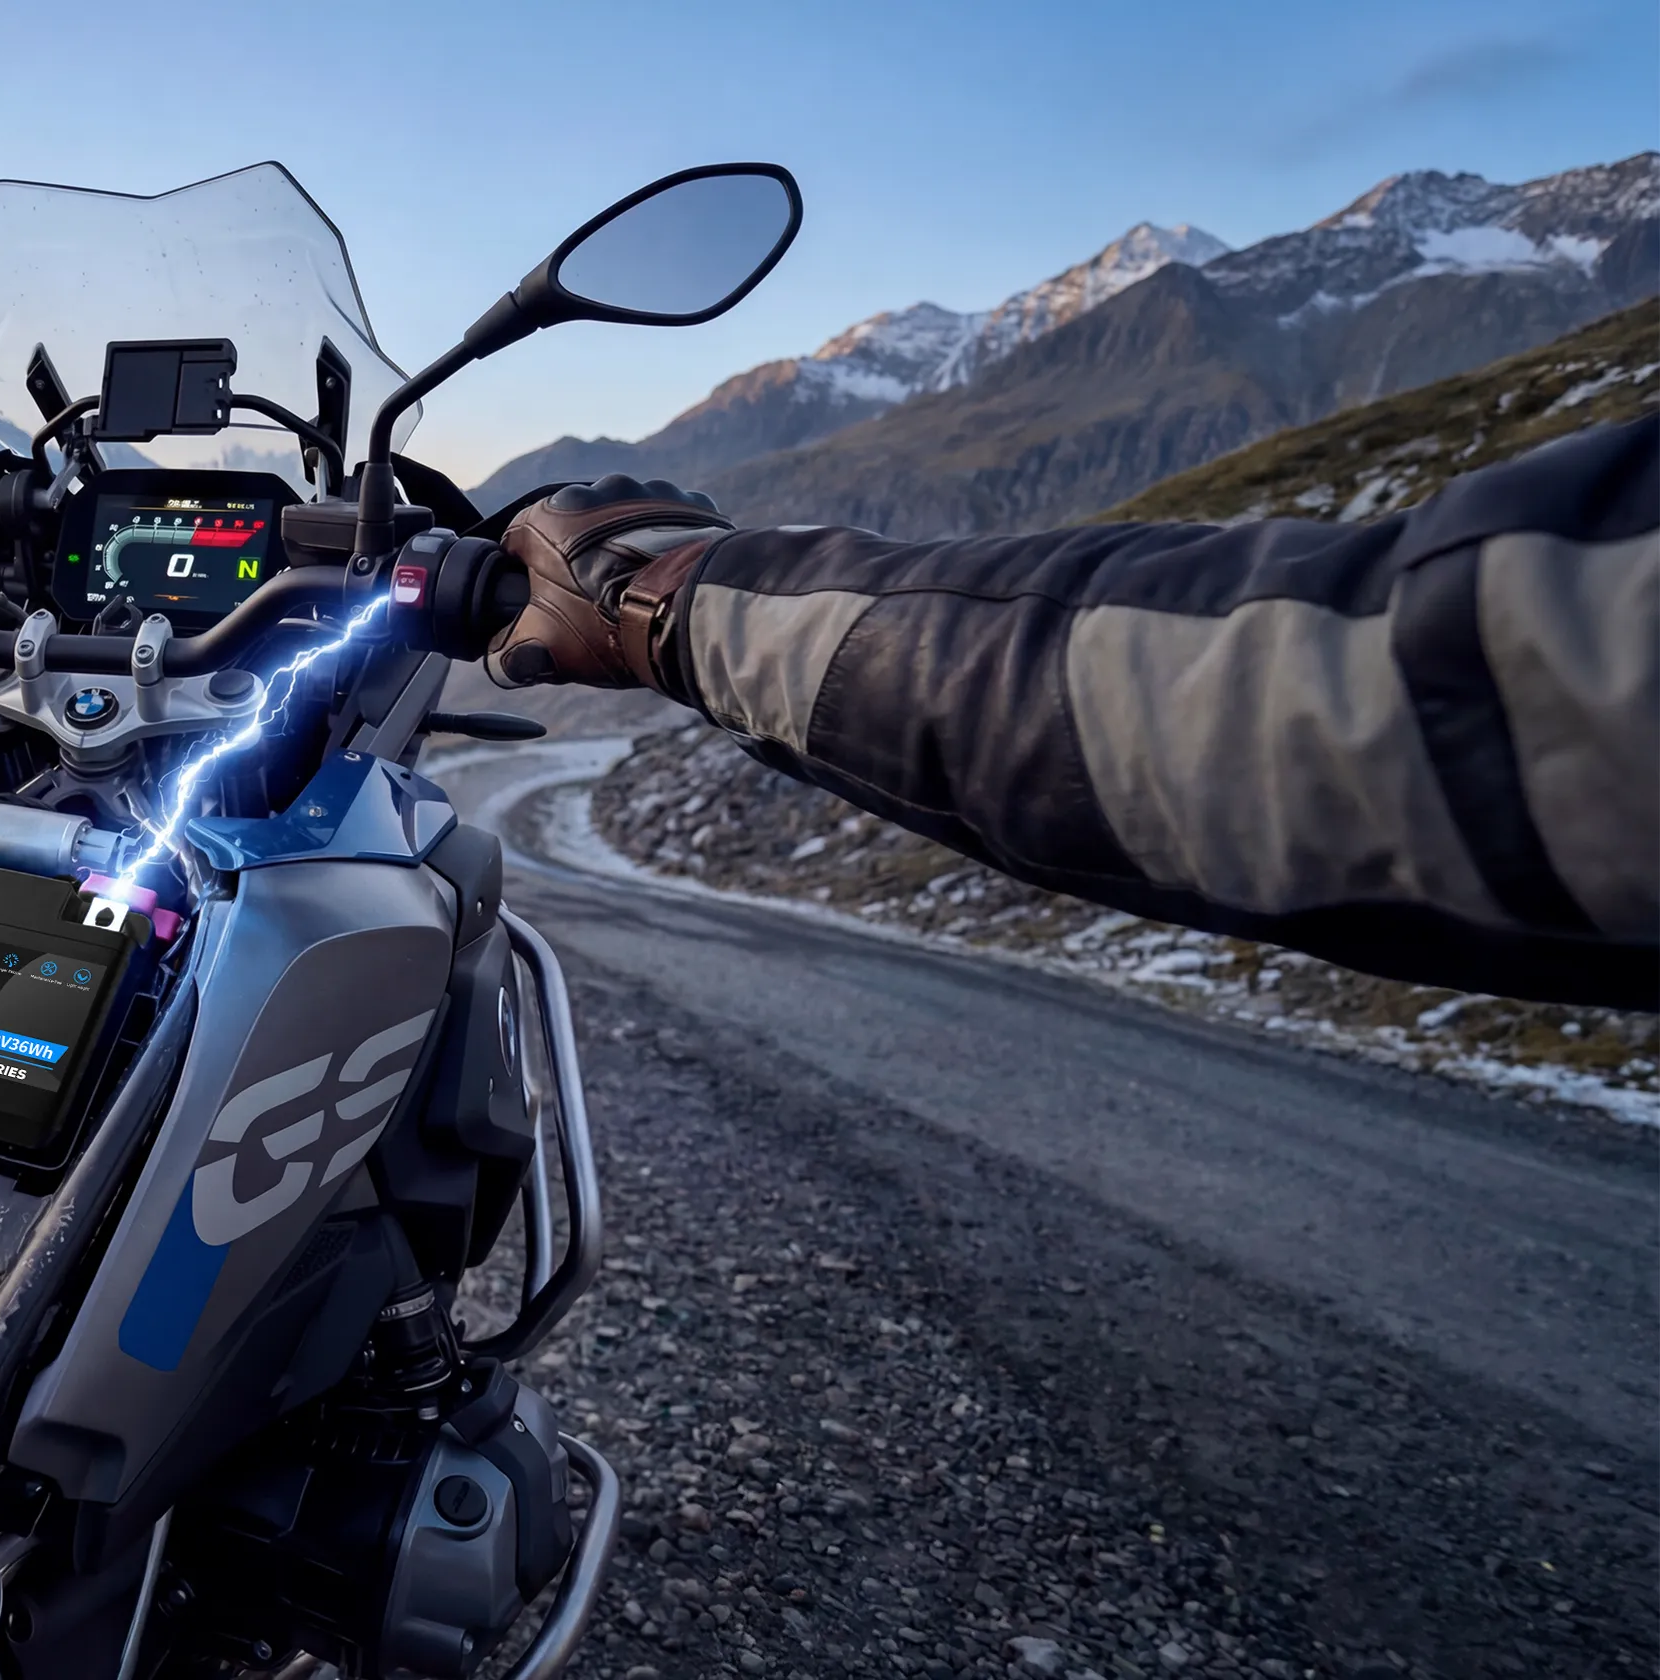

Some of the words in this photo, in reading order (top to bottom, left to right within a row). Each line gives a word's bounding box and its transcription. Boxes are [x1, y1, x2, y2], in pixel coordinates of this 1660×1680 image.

[167, 553, 195, 578] 0
[238, 559, 258, 579] N
[192, 1009, 436, 1247] GS
